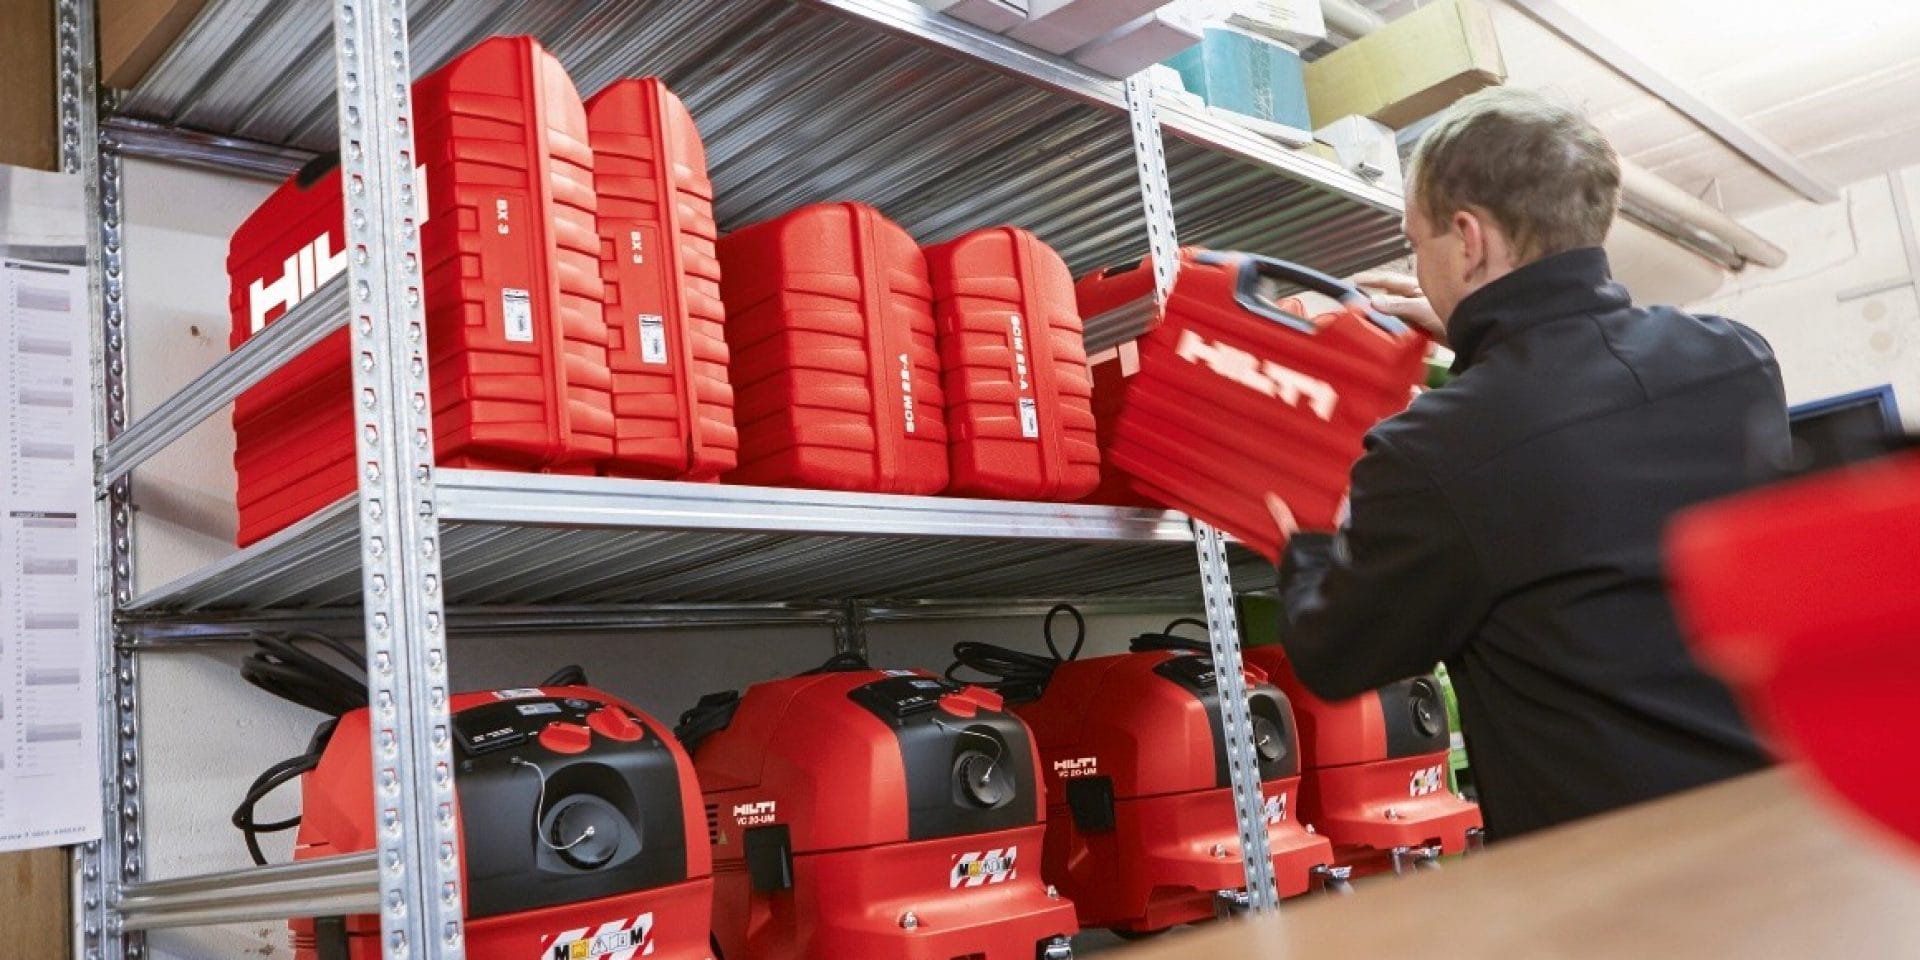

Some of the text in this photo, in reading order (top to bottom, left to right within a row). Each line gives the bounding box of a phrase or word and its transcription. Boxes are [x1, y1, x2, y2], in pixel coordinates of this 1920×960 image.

[496, 199, 509, 235] BX 3
[1175, 328, 1338, 423] HILTI
[1053, 757, 1097, 770] HILTI
[732, 800, 776, 817] HILTI
[554, 926, 643, 960] M M
